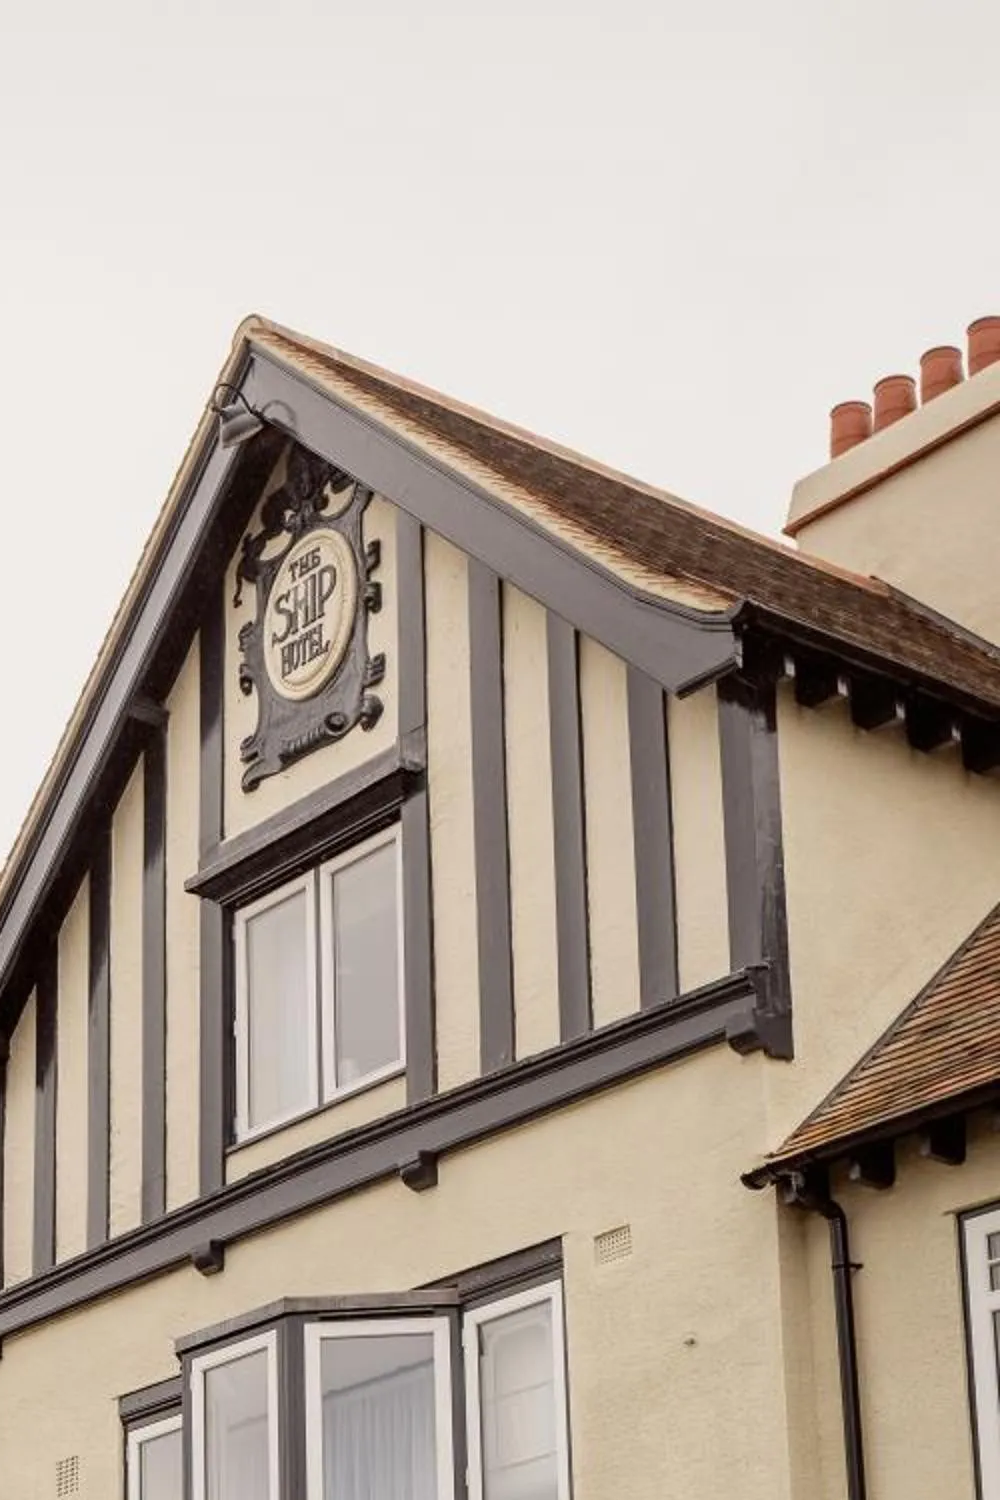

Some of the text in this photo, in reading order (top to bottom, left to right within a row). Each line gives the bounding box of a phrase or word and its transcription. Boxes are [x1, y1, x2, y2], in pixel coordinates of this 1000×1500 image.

[288, 546, 320, 582] THE
[271, 564, 336, 648] SHIP
[280, 623, 330, 679] HOTEL
